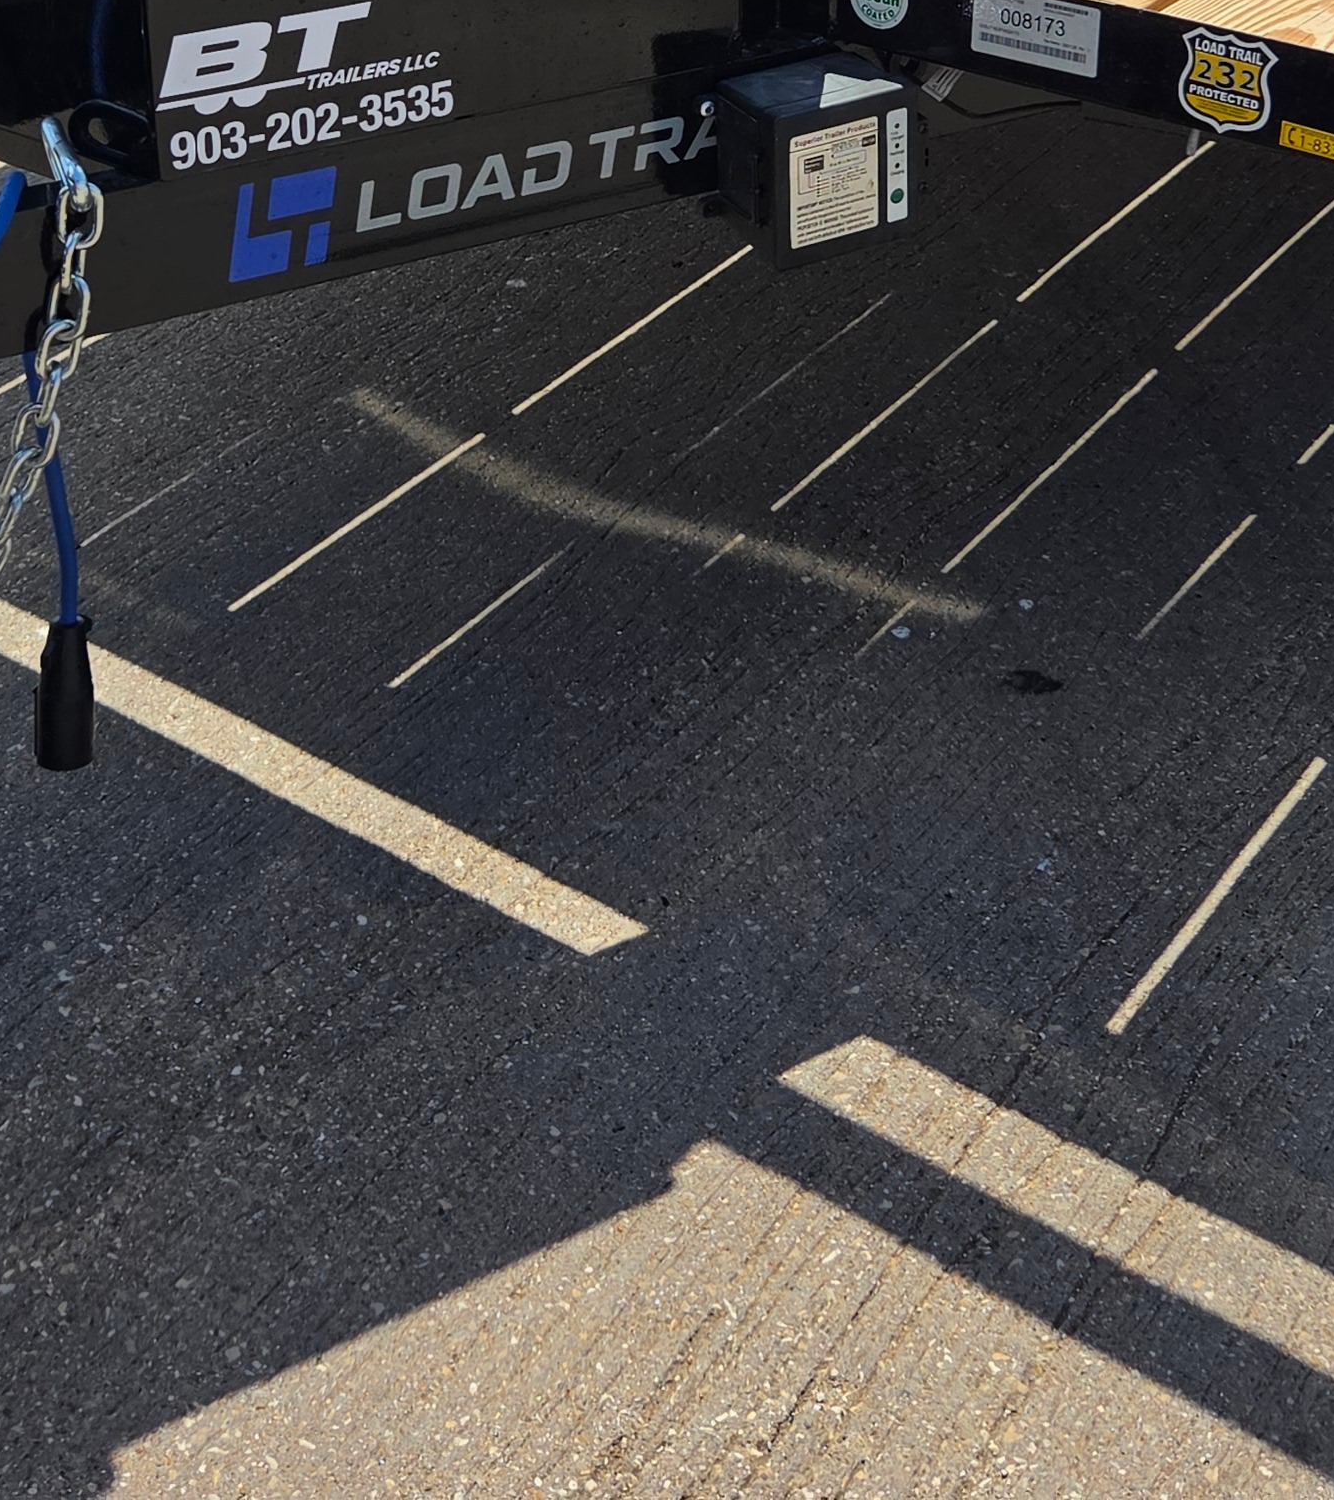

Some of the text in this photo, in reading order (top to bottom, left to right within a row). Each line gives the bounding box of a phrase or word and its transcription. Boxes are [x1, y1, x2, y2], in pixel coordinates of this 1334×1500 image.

[861, 4, 895, 20] COATED
[1000, 8, 1066, 37] 008173
[157, 1, 372, 100] BT
[1195, 37, 1264, 66] LOAD TRAIL
[306, 51, 441, 91] TRAILERS LLC
[1197, 58, 1255, 91] 232
[1188, 83, 1259, 110] PROTECTED
[169, 79, 455, 171] 903-202-3535
[356, 143, 572, 234] LOAD
